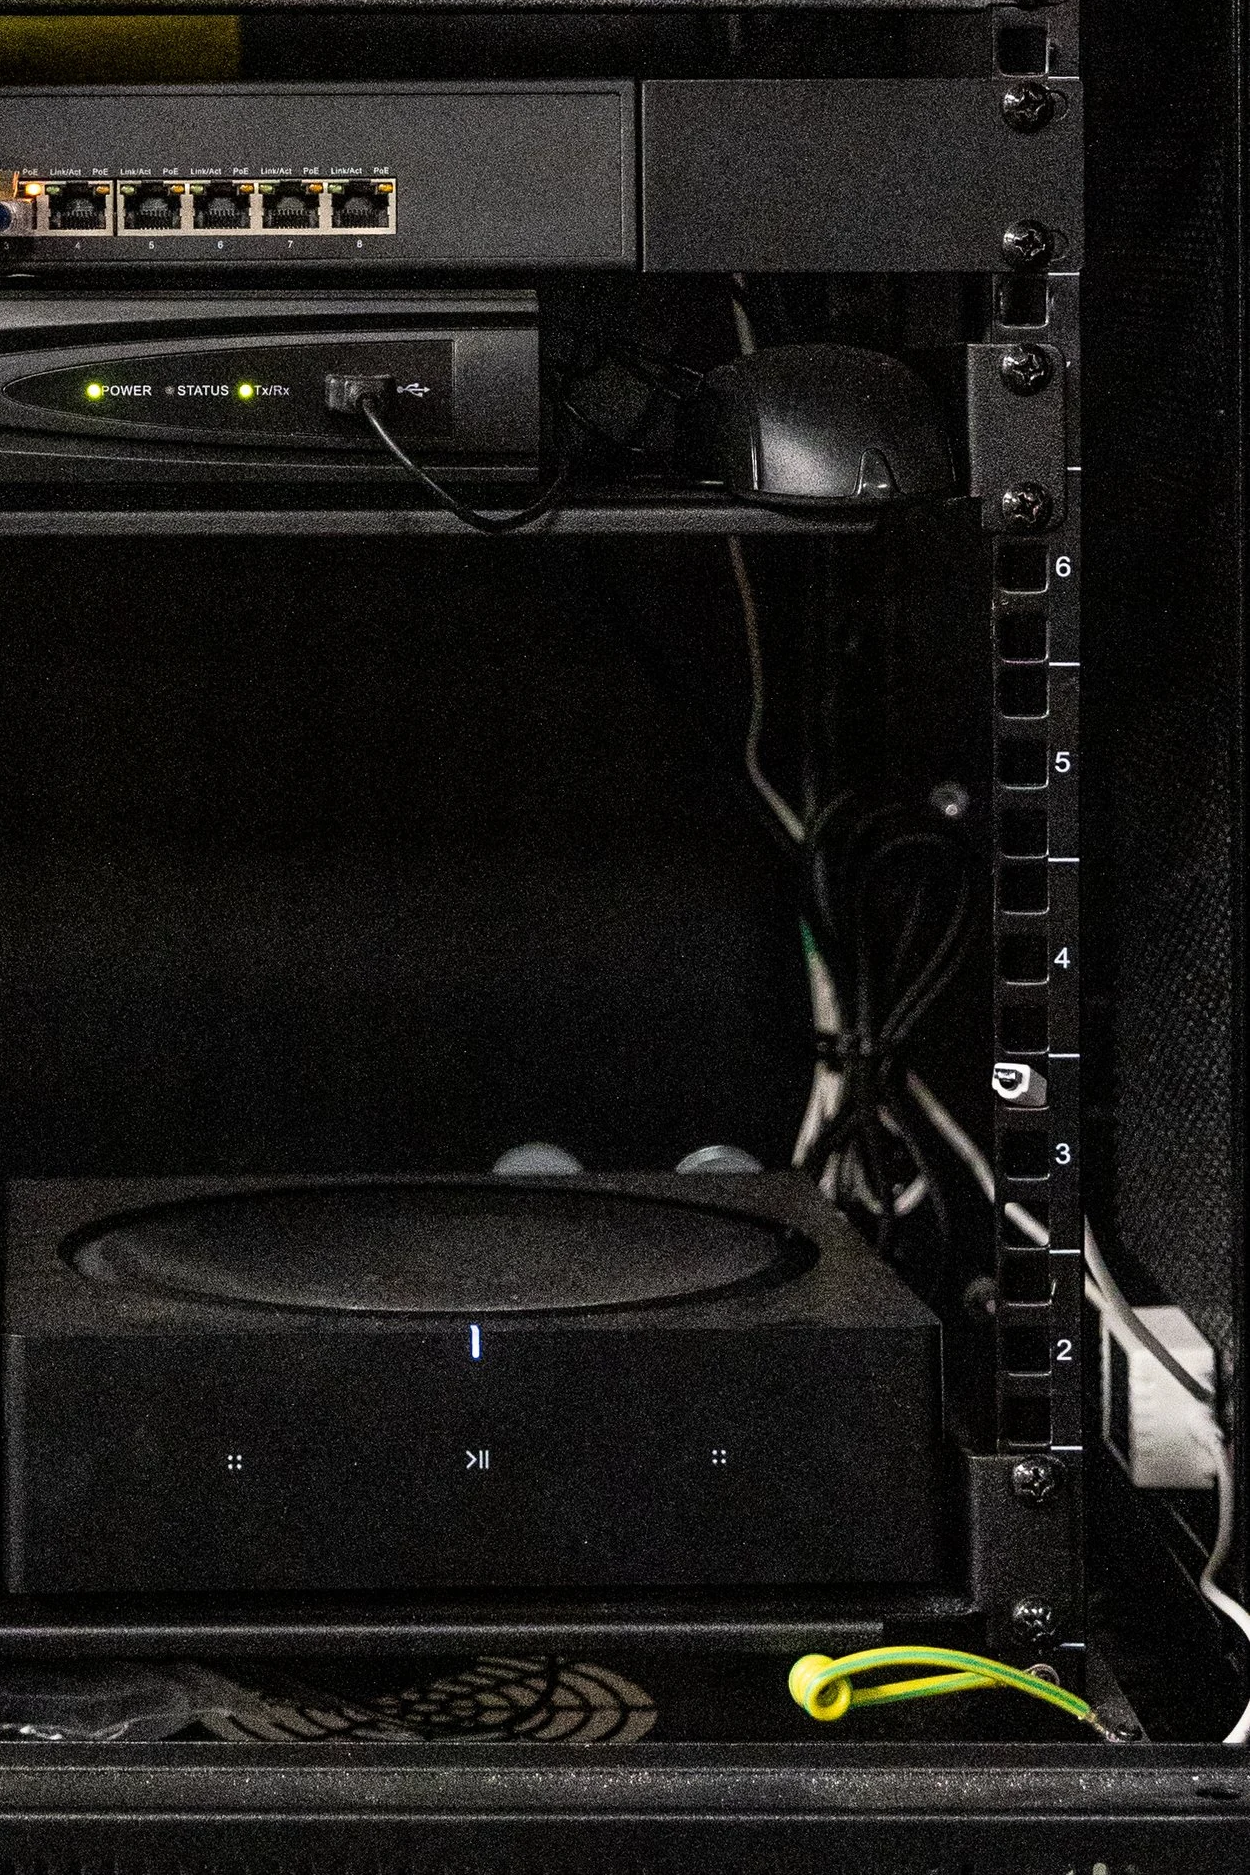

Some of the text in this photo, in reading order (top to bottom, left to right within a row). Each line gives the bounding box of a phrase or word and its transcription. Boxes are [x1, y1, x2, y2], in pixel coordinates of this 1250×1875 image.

[22, 168, 39, 176] PoE
[50, 167, 81, 176] Link/Act
[93, 167, 108, 176] PoE
[120, 167, 151, 176] Link/Act
[163, 167, 179, 176] PoE
[191, 167, 222, 176] Link/Act
[233, 167, 249, 176] PoE
[261, 167, 292, 176] Link/Act
[303, 167, 320, 176] PoE
[331, 167, 362, 176] Link/Act
[374, 167, 390, 176] PoE
[3, 241, 10, 251] 3
[74, 241, 81, 250] 4
[148, 240, 155, 250] 5
[217, 240, 224, 250] 6
[287, 239, 294, 249] 7
[356, 239, 364, 249] 8
[101, 385, 152, 396] POWER
[177, 385, 229, 396] STATUS
[254, 385, 289, 397] Tx/Rx
[1055, 555, 1072, 578] 6
[1054, 751, 1071, 773] 5
[1053, 947, 1071, 969] 4
[1055, 1142, 1072, 1165] 3
[1056, 1338, 1073, 1361] 2
